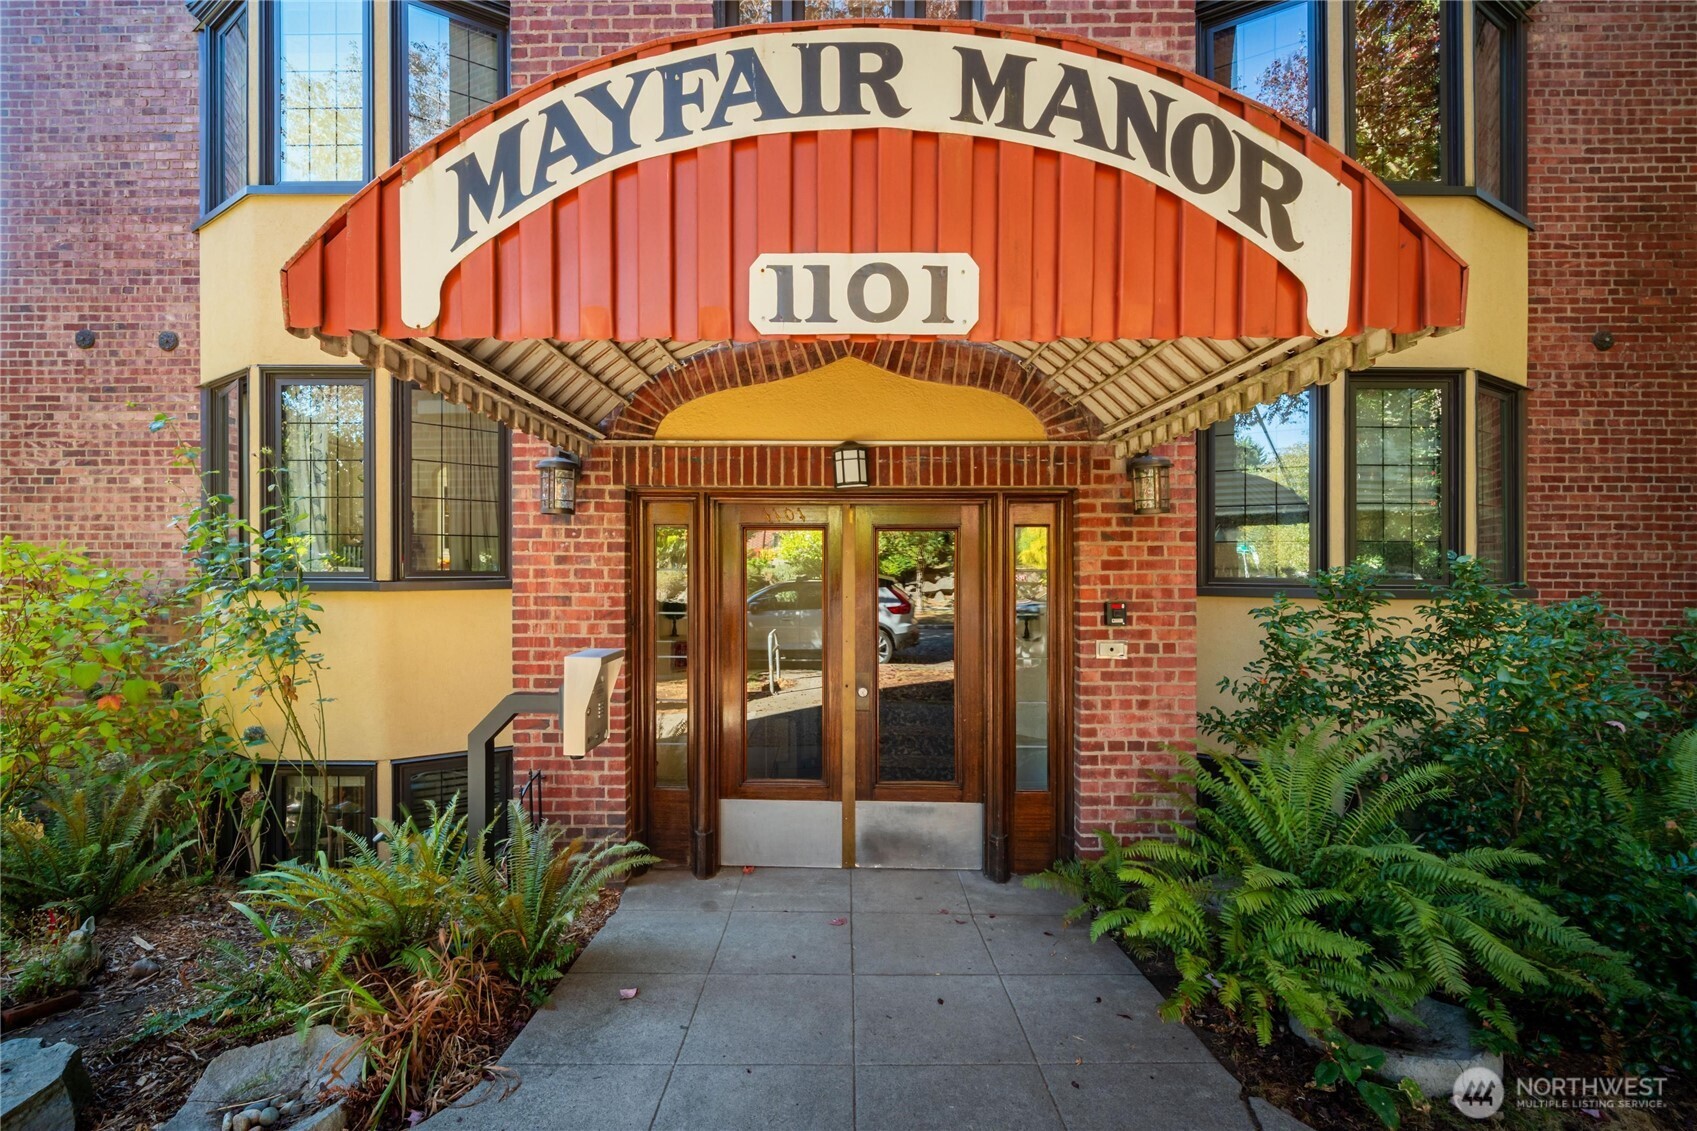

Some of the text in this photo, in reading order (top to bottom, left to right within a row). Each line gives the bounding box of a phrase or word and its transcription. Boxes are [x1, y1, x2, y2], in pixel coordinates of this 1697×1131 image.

[446, 42, 1304, 253] MAYFAIR MANOR
[766, 262, 954, 323] 1101
